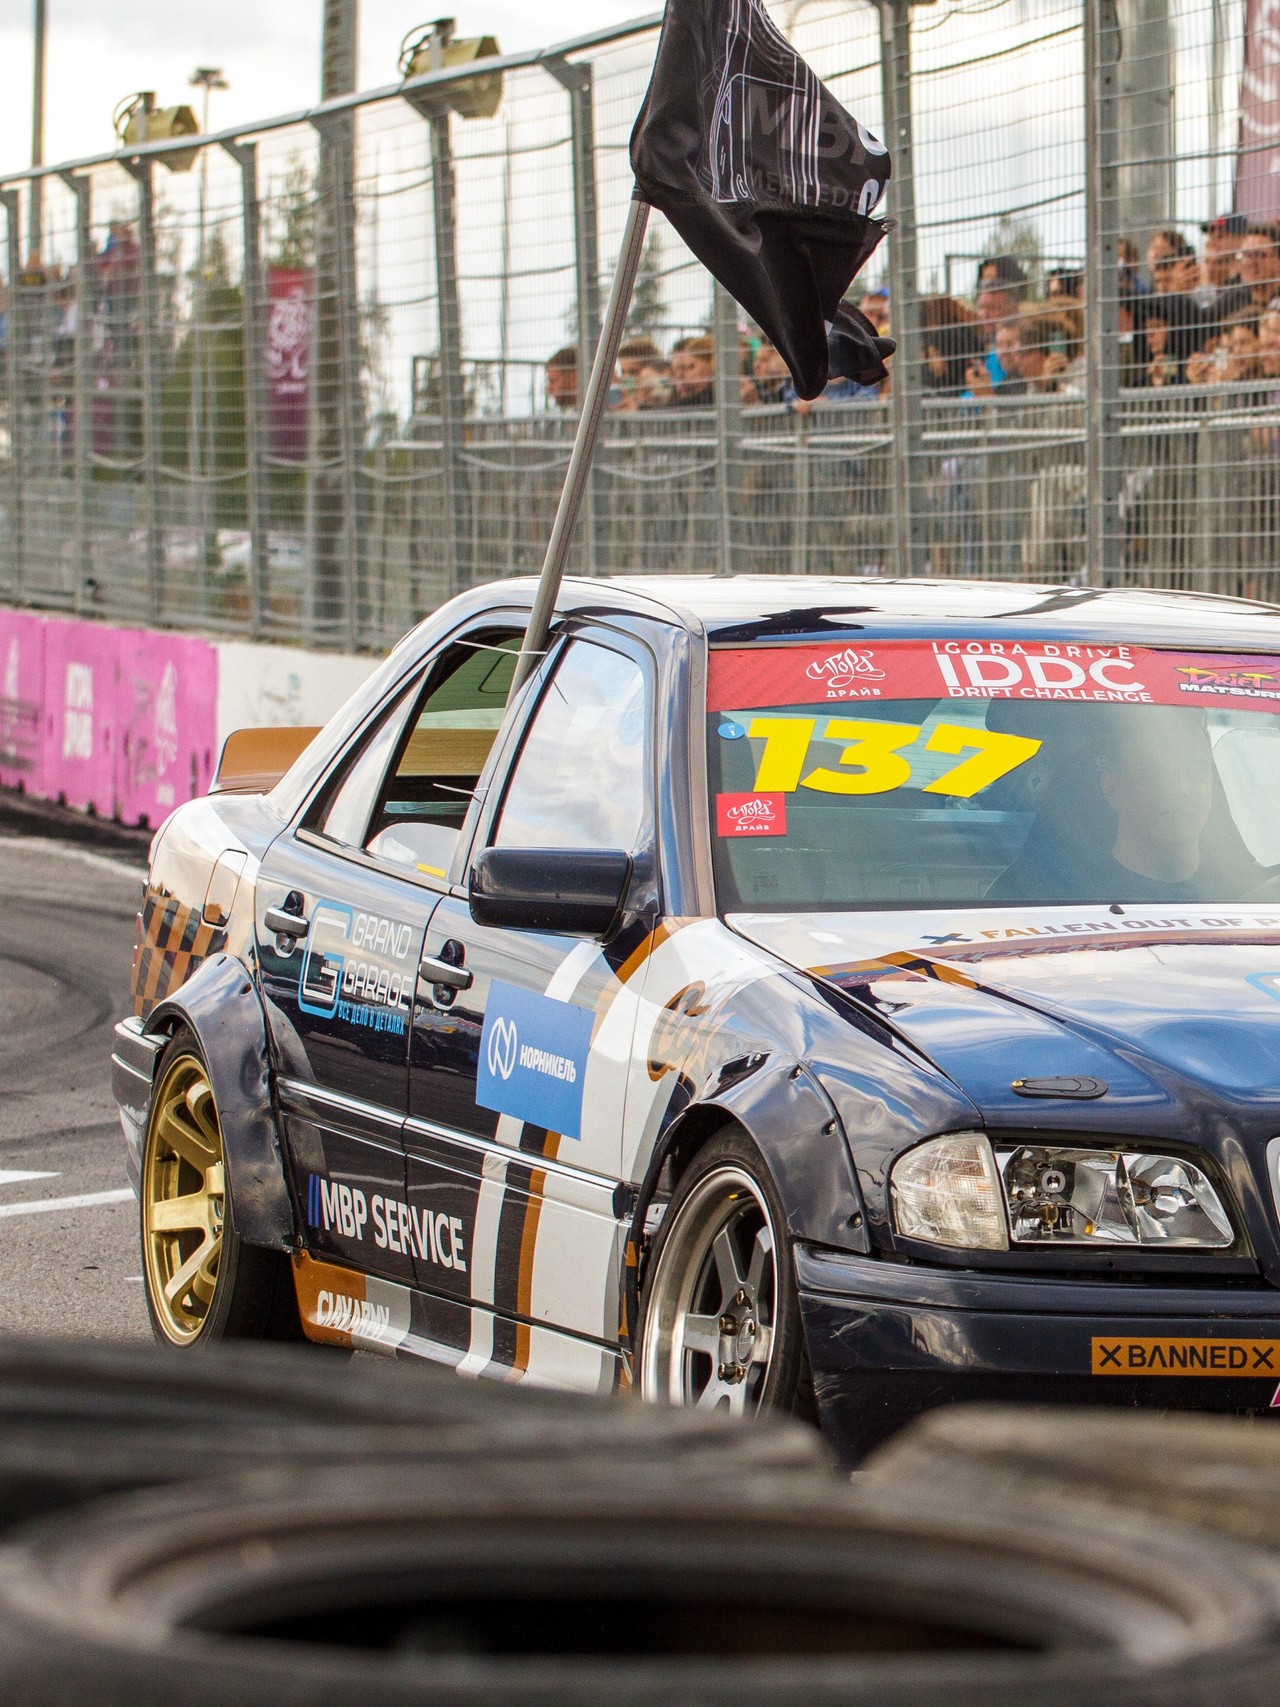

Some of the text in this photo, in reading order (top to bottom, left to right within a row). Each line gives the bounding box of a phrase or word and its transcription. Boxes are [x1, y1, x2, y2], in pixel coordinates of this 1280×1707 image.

[932, 642, 1132, 659] IGORA DRIVE
[935, 654, 1146, 692] IDDC
[826, 687, 881, 698] ДРАЙВ
[948, 687, 1155, 703] DRIFT CHALLENGE
[748, 718, 1043, 798] 137
[352, 913, 412, 959] GRAND
[979, 921, 1119, 939] FALLEN
[1121, 919, 1194, 929] OUT
[1199, 918, 1243, 927] OF
[343, 960, 414, 1011] GARAGE
[338, 1000, 405, 1036] ВСЕ ДЕЛО В ДЕТАЛЯХ
[519, 1044, 577, 1083] НОРНИКЕЛЬ
[320, 1178, 467, 1272] MBP SERVICE
